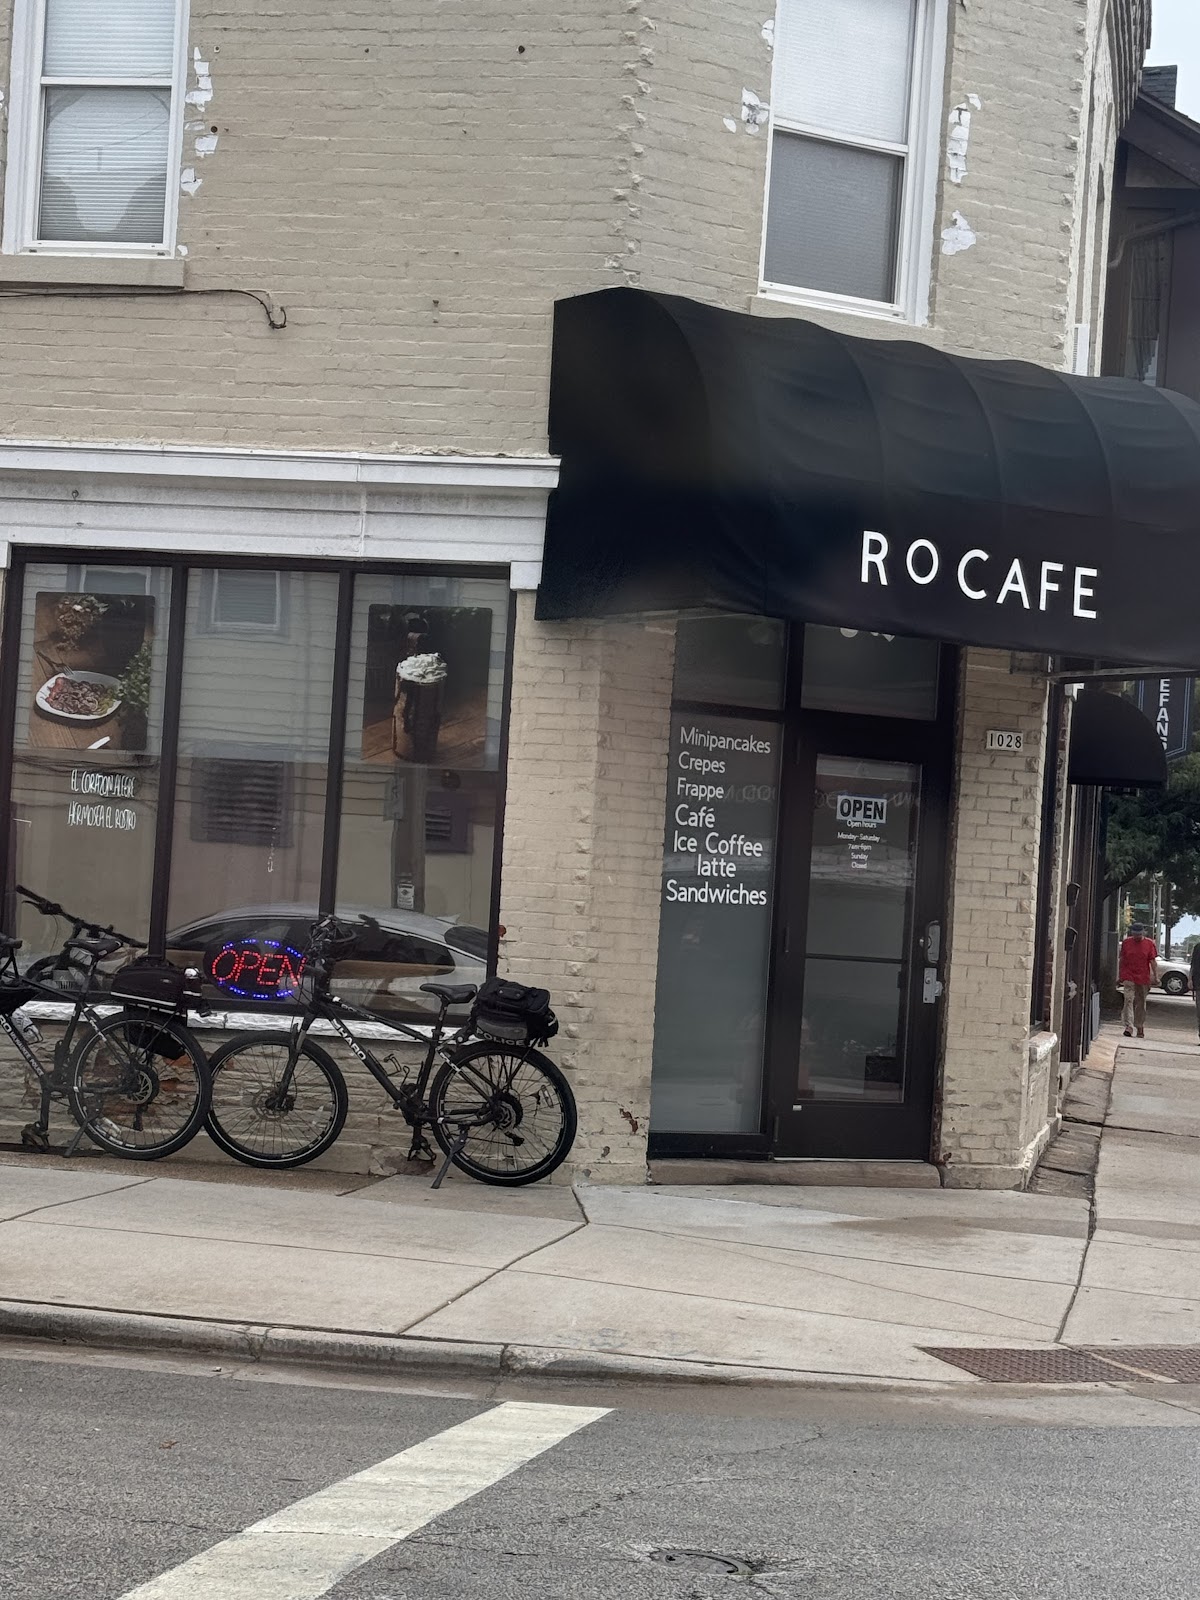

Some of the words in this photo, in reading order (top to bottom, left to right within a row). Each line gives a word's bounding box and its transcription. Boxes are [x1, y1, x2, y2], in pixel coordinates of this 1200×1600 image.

[680, 726, 771, 754] Minipancakes
[990, 733, 1022, 749] 1028
[678, 751, 726, 775] Crepes
[677, 777, 724, 802] Frappe
[675, 804, 716, 828] Café
[840, 799, 884, 821] OPEN
[847, 819, 861, 829] Open
[862, 820, 877, 829] hours
[673, 830, 698, 853] Ice
[705, 832, 763, 857] Coffee
[697, 854, 736, 877] latte
[851, 852, 868, 861] Sunday
[666, 879, 767, 905] Sandwiches
[211, 949, 308, 987] OPEN
[338, 1027, 367, 1061] HARO
[476, 1026, 525, 1046] POLICE
[29, 1058, 45, 1077] POLICE
